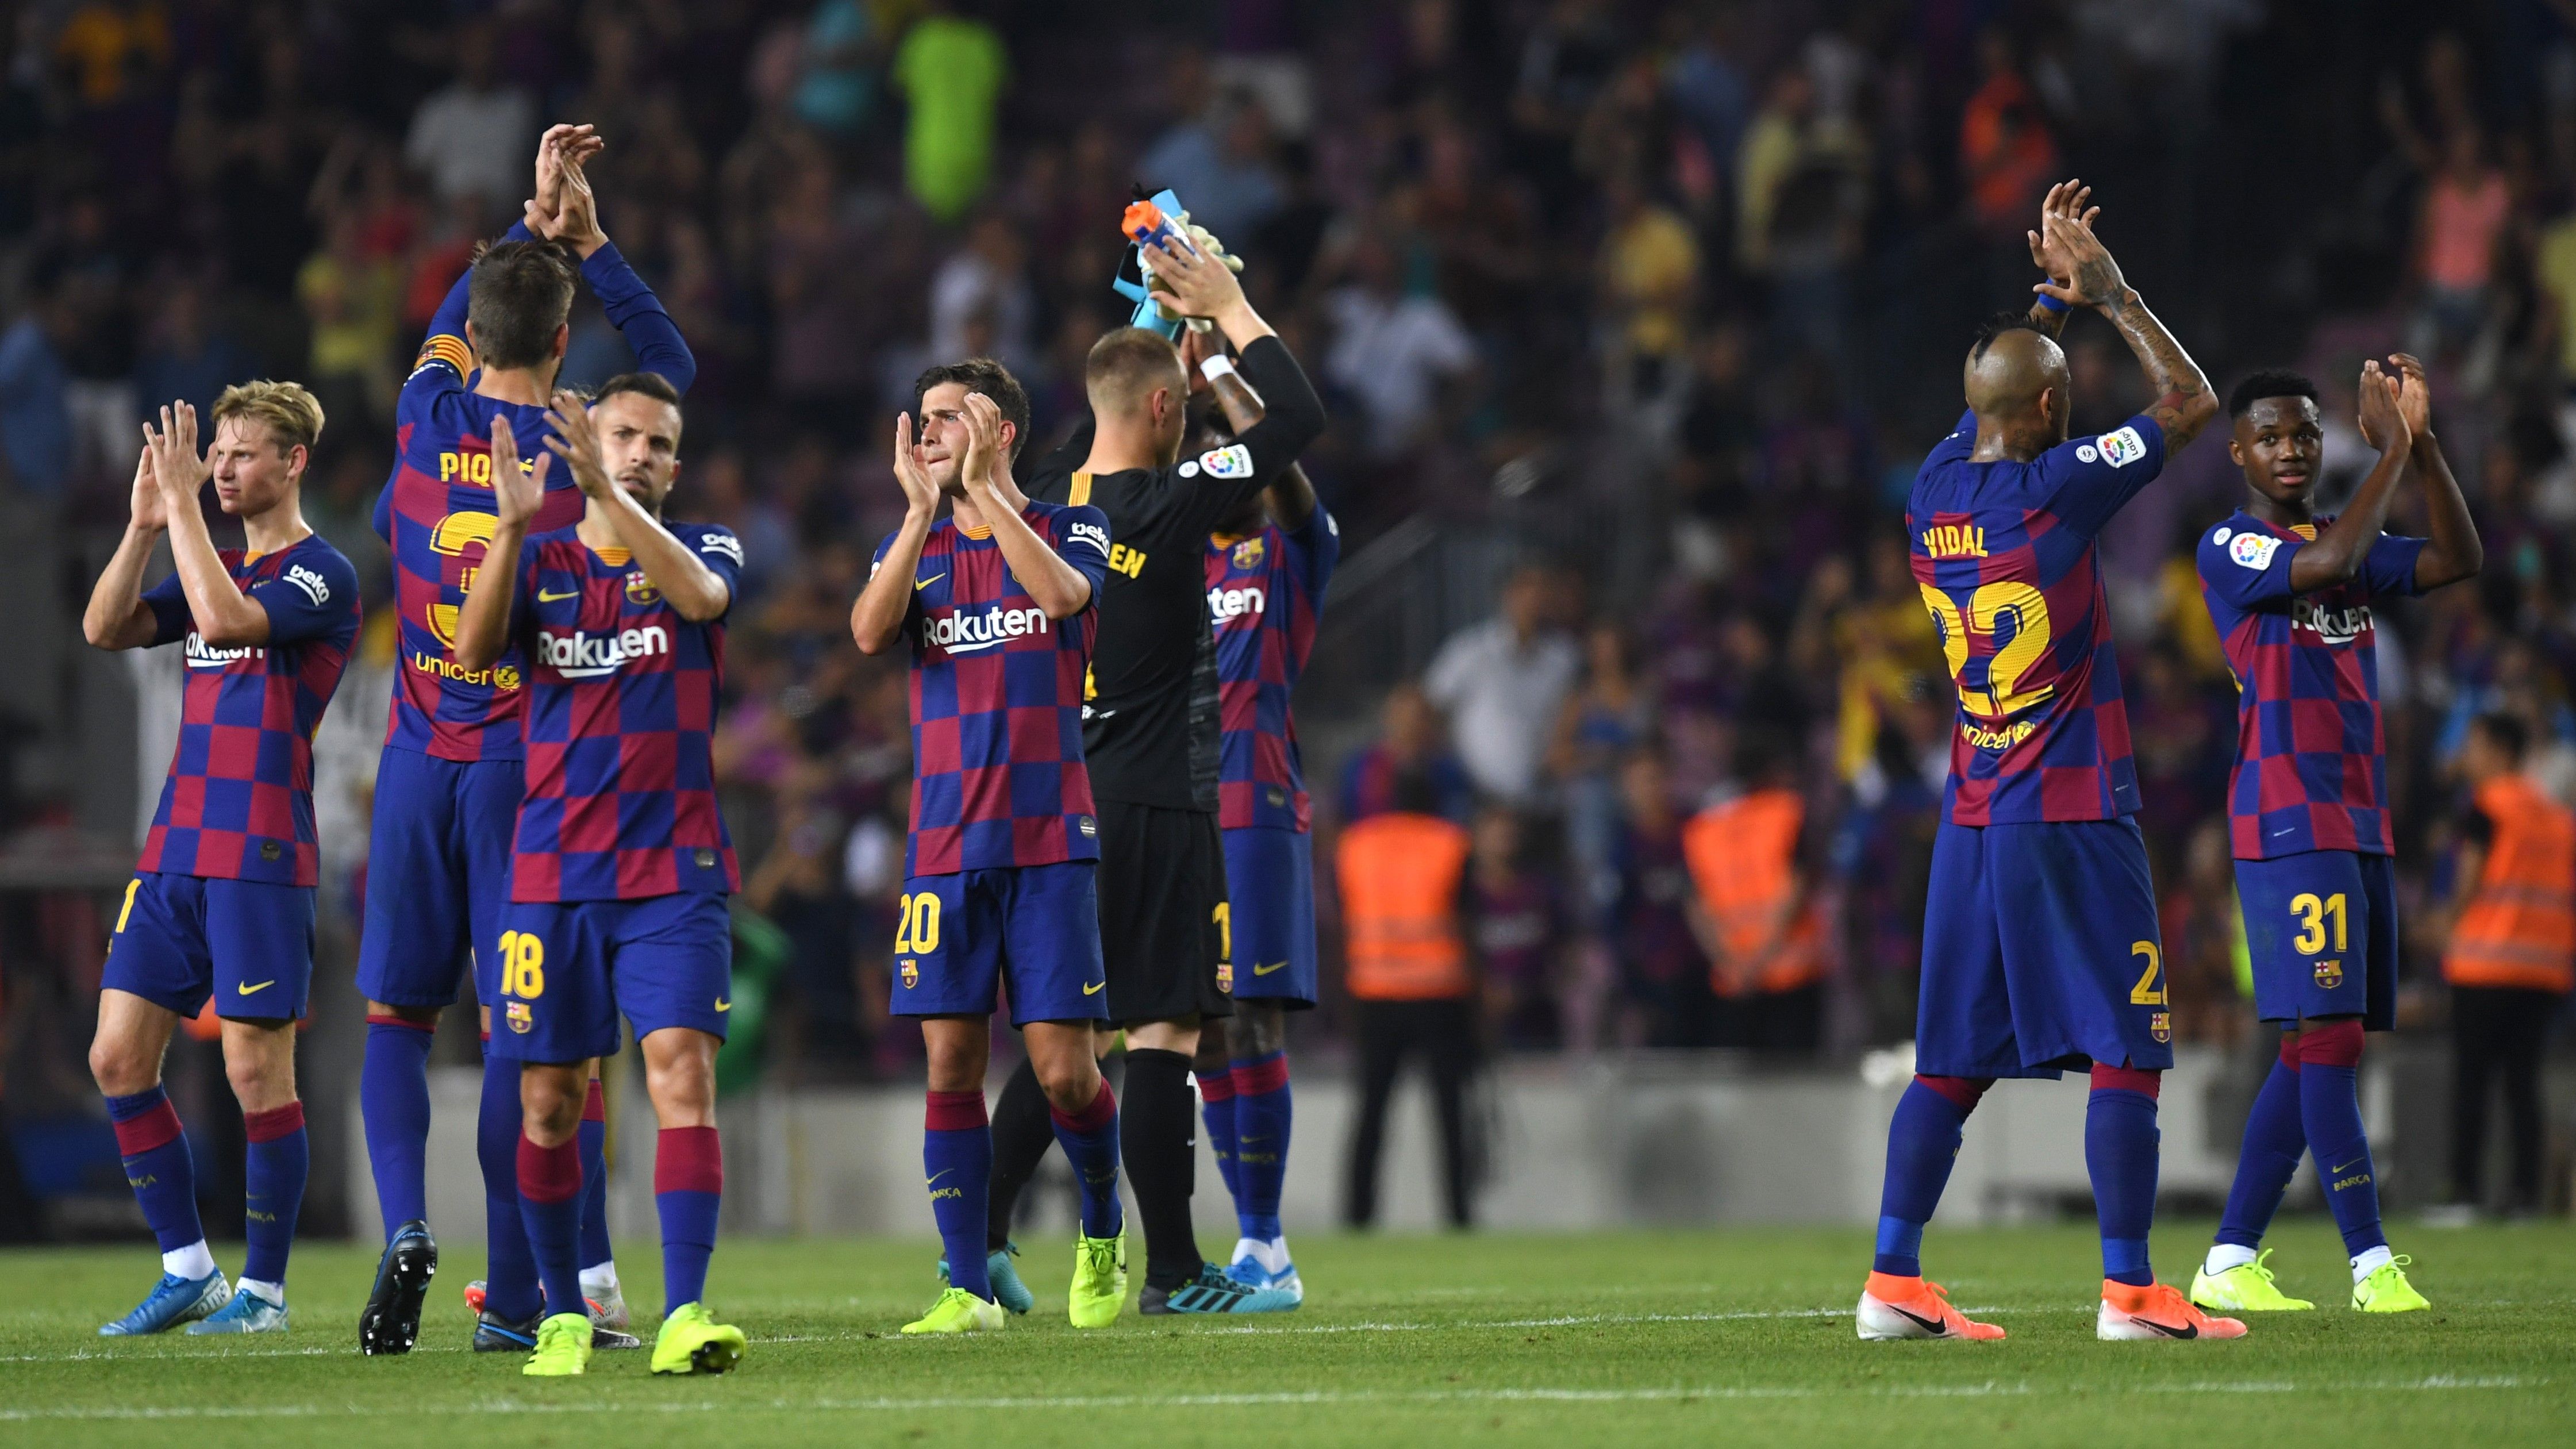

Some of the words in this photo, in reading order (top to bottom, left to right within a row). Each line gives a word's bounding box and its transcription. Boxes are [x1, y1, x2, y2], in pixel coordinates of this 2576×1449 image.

[1922, 525, 1989, 559] VIDAL
[289, 564, 329, 604] beko
[922, 606, 1047, 648] Rakuten
[894, 891, 941, 955] 20
[1212, 901, 1231, 960] 1
[2289, 893, 2347, 956] 31
[498, 929, 545, 1000] 18
[2130, 940, 2169, 1006] 2
